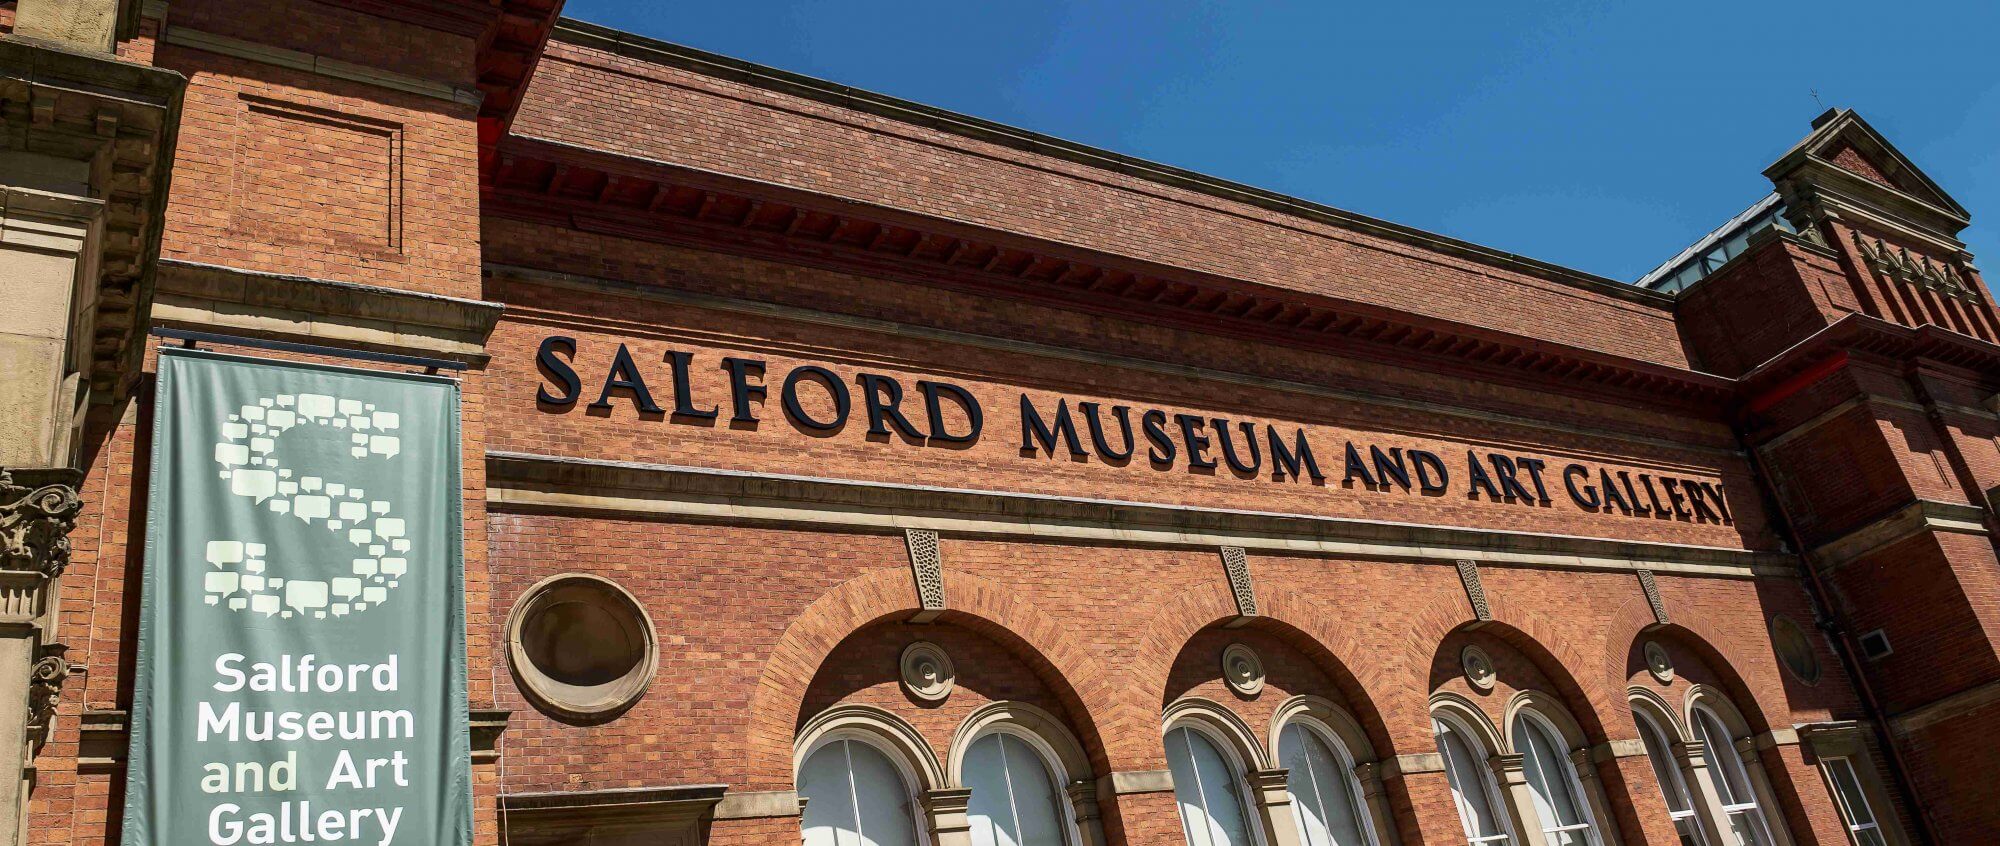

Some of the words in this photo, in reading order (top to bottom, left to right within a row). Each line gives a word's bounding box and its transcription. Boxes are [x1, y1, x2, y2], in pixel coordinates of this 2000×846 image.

[535, 335, 984, 447] SALFORD
[1018, 392, 1326, 486] MUSEUM
[1341, 440, 1449, 496] AND
[1467, 450, 1552, 507] ART
[1563, 463, 1735, 526] GALLERY
[212, 653, 399, 693] Salford
[197, 701, 415, 742] Museum
[200, 751, 298, 793] and
[326, 750, 410, 791] Art
[208, 801, 404, 846] Gallery
